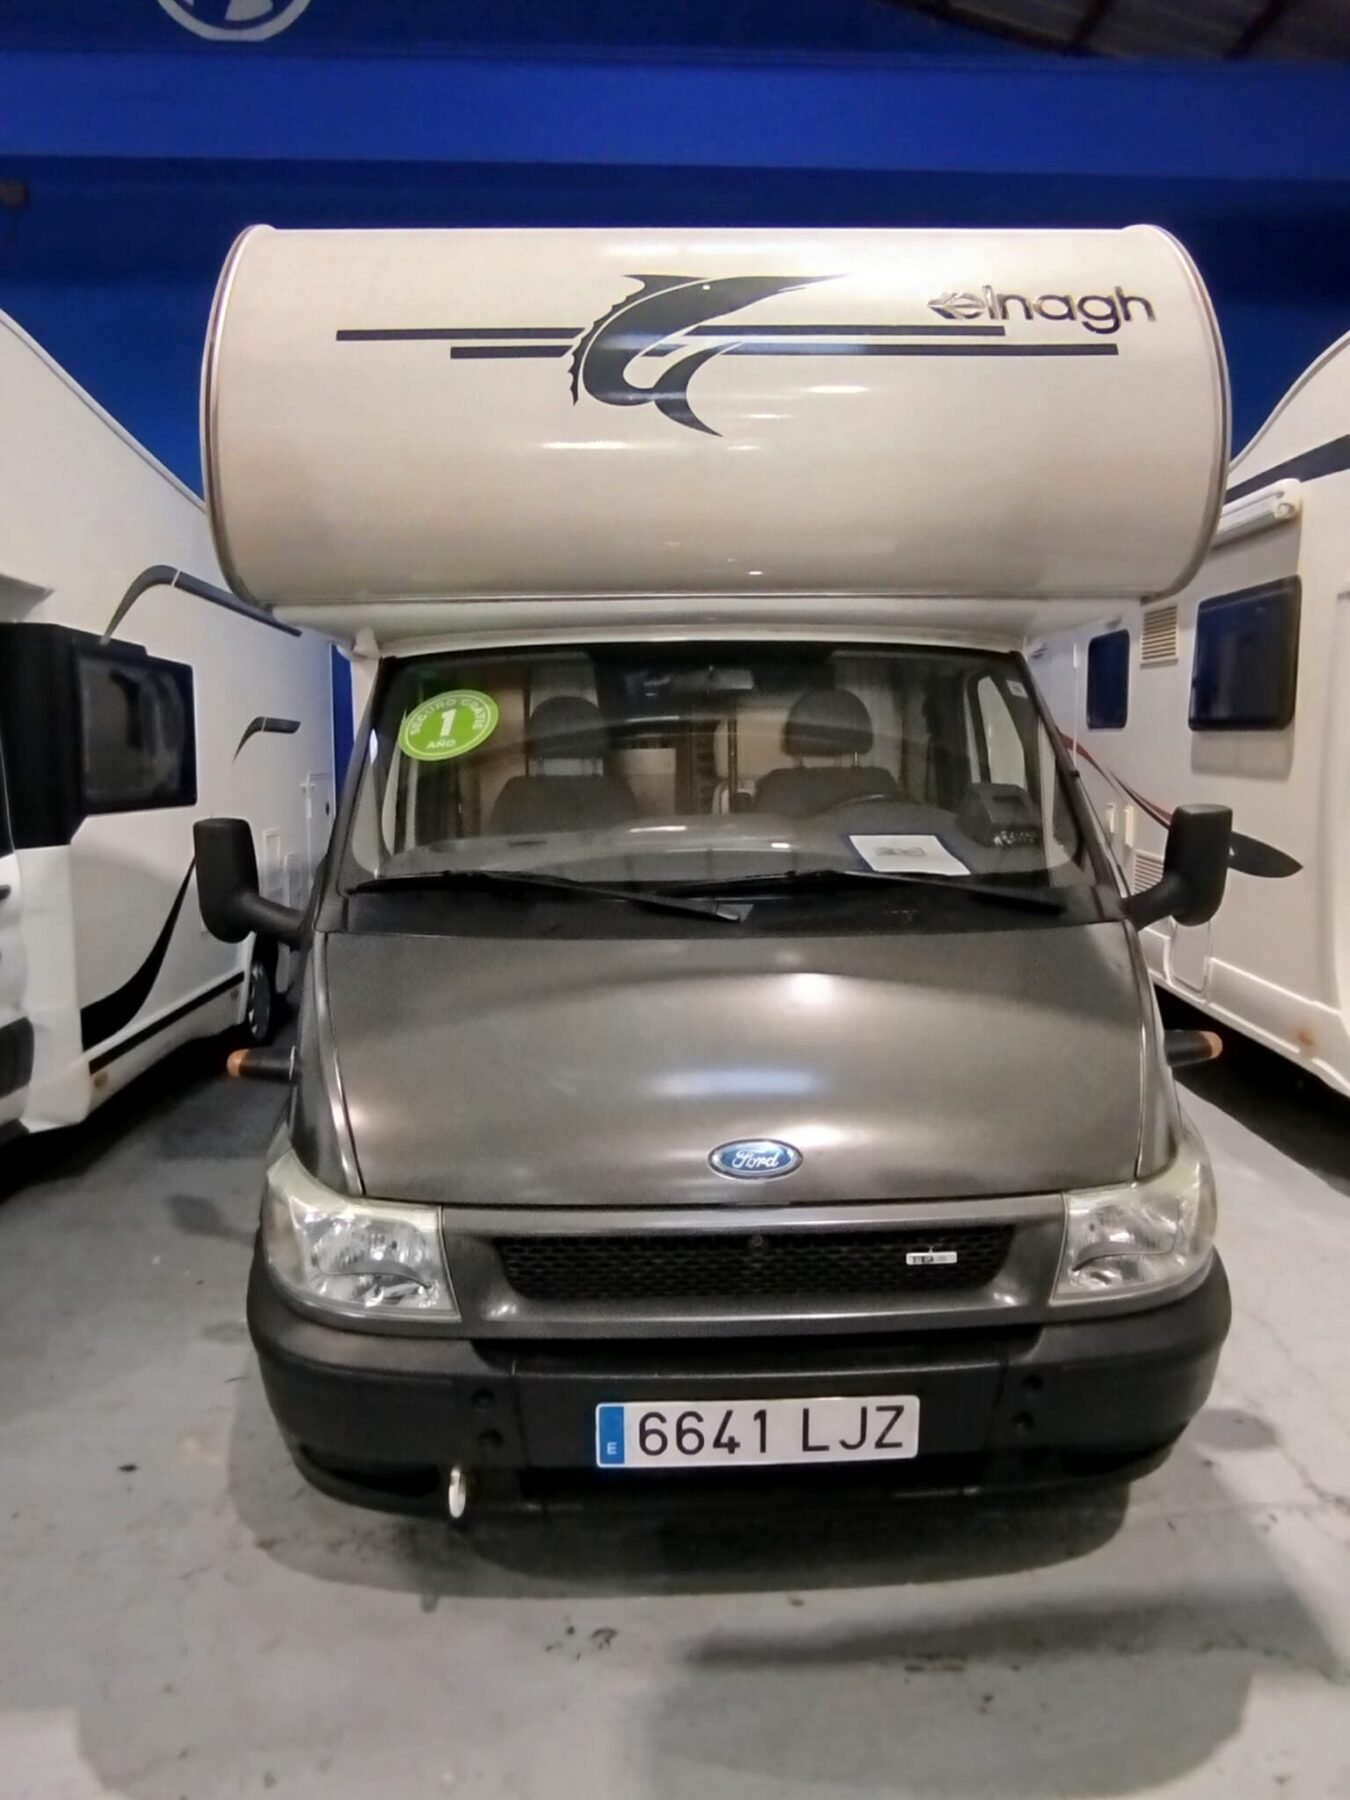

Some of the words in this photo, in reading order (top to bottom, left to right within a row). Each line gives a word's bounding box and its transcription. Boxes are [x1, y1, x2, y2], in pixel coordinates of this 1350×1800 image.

[929, 285, 1156, 334] elnagh
[410, 698, 457, 735] SEGURO
[441, 709, 457, 737] 1
[427, 739, 456, 749] AÑO
[731, 1150, 779, 1169] Ford
[637, 1408, 768, 1456] 6641
[801, 1405, 905, 1452] LJZ
[606, 1442, 617, 1455] E
